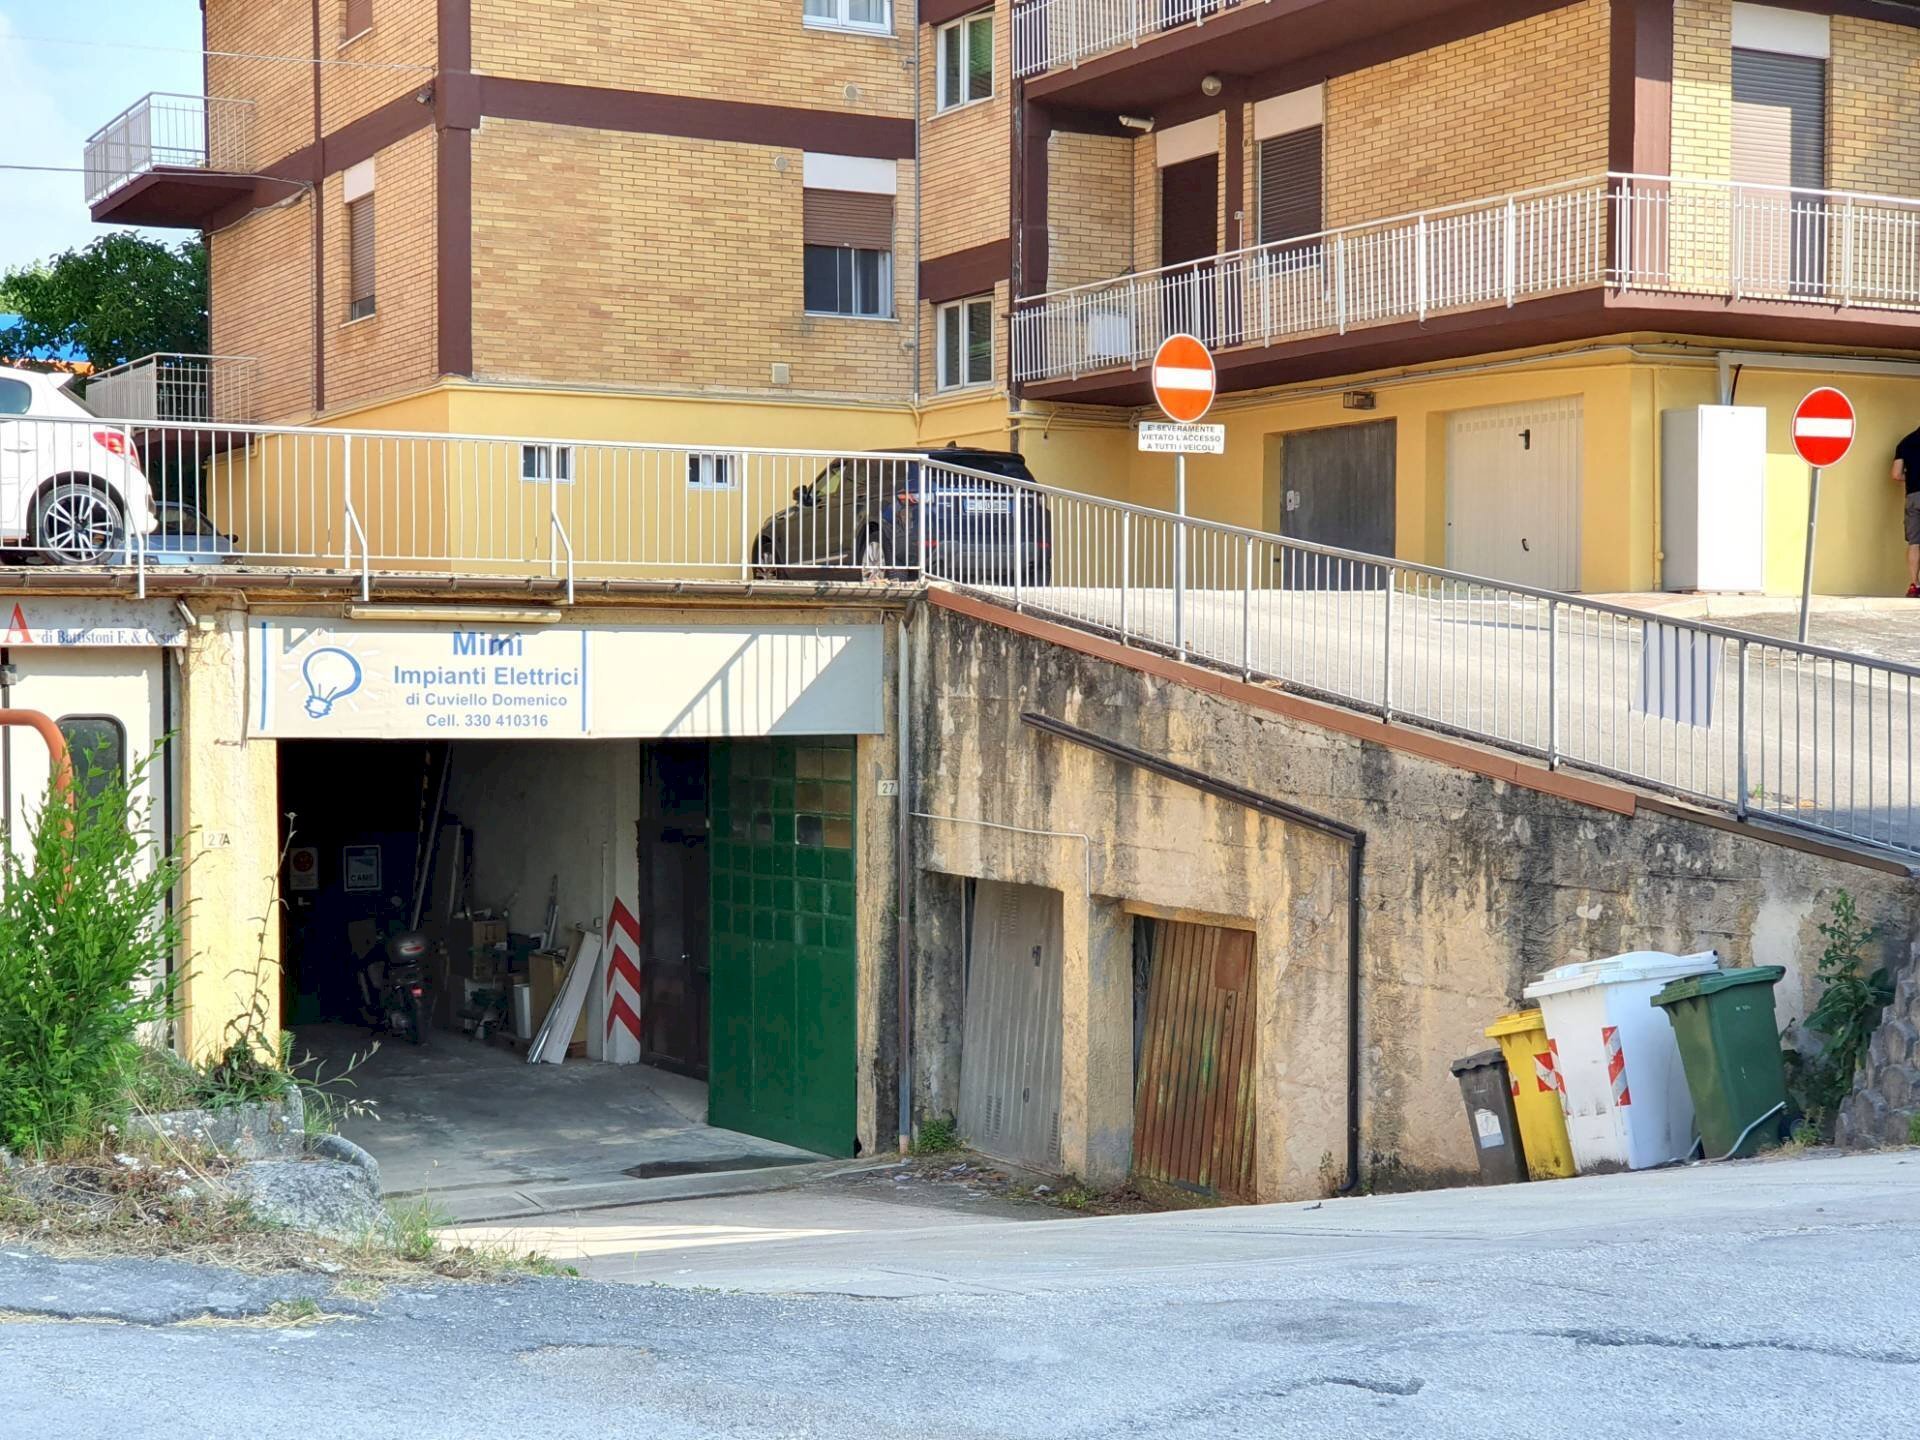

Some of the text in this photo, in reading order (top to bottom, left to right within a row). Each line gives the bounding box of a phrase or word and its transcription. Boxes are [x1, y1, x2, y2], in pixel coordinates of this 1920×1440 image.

[1157, 424, 1215, 433] SEVERAMENTE
[1141, 433, 1221, 442] VIETATO L'ACCESSO
[41, 630, 53, 644] di
[57, 630, 113, 644] Battistoni
[117, 631, 127, 644] F.
[131, 631, 142, 644] &
[453, 631, 523, 656] Mimì
[394, 665, 578, 689] Impianti Elettrici
[405, 693, 567, 706] di Cuviello Domenico
[426, 713, 548, 727] Cell. 330 410316
[882, 782, 895, 794] 27
